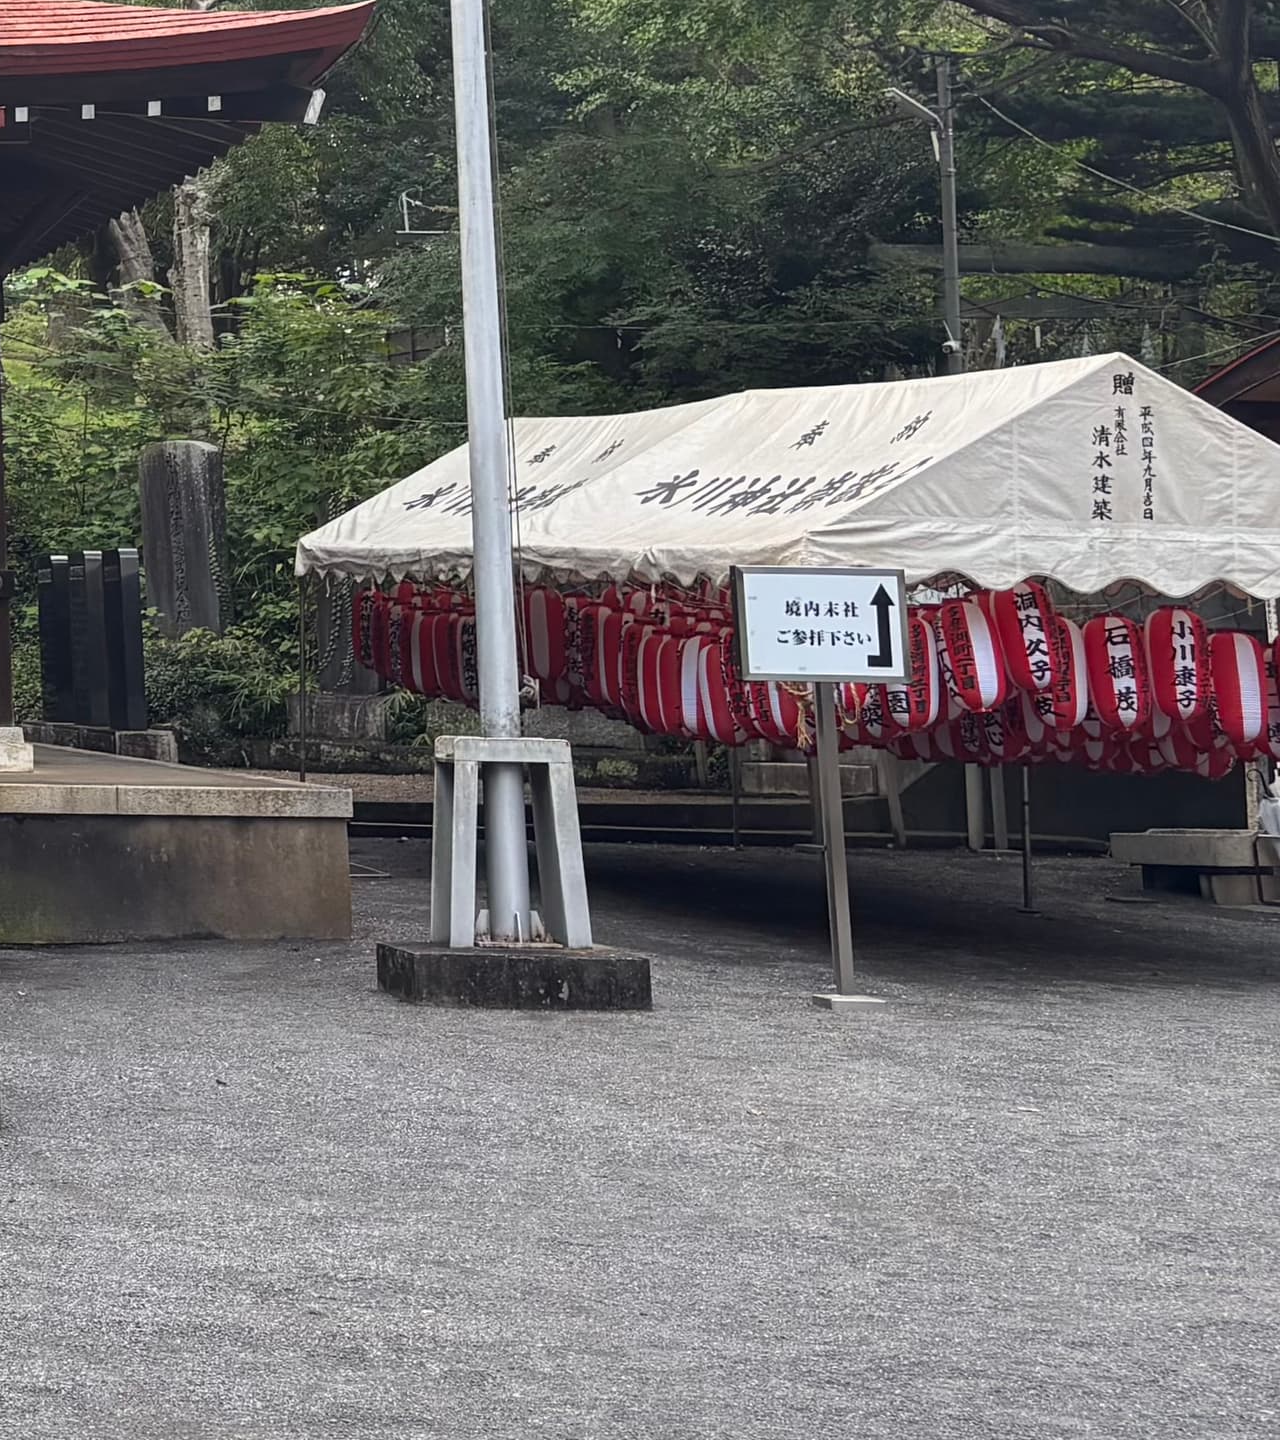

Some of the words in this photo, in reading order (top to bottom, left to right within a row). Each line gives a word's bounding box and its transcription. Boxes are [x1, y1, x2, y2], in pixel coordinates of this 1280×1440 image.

[1112, 372, 1135, 396] 贈
[1114, 406, 1128, 456] 有限会社
[1092, 425, 1113, 521] 清水建築
[1139, 406, 1158, 521] 平成四年九月吉日
[785, 600, 860, 618] 境内末社
[777, 629, 872, 647] ご参拝下さい
